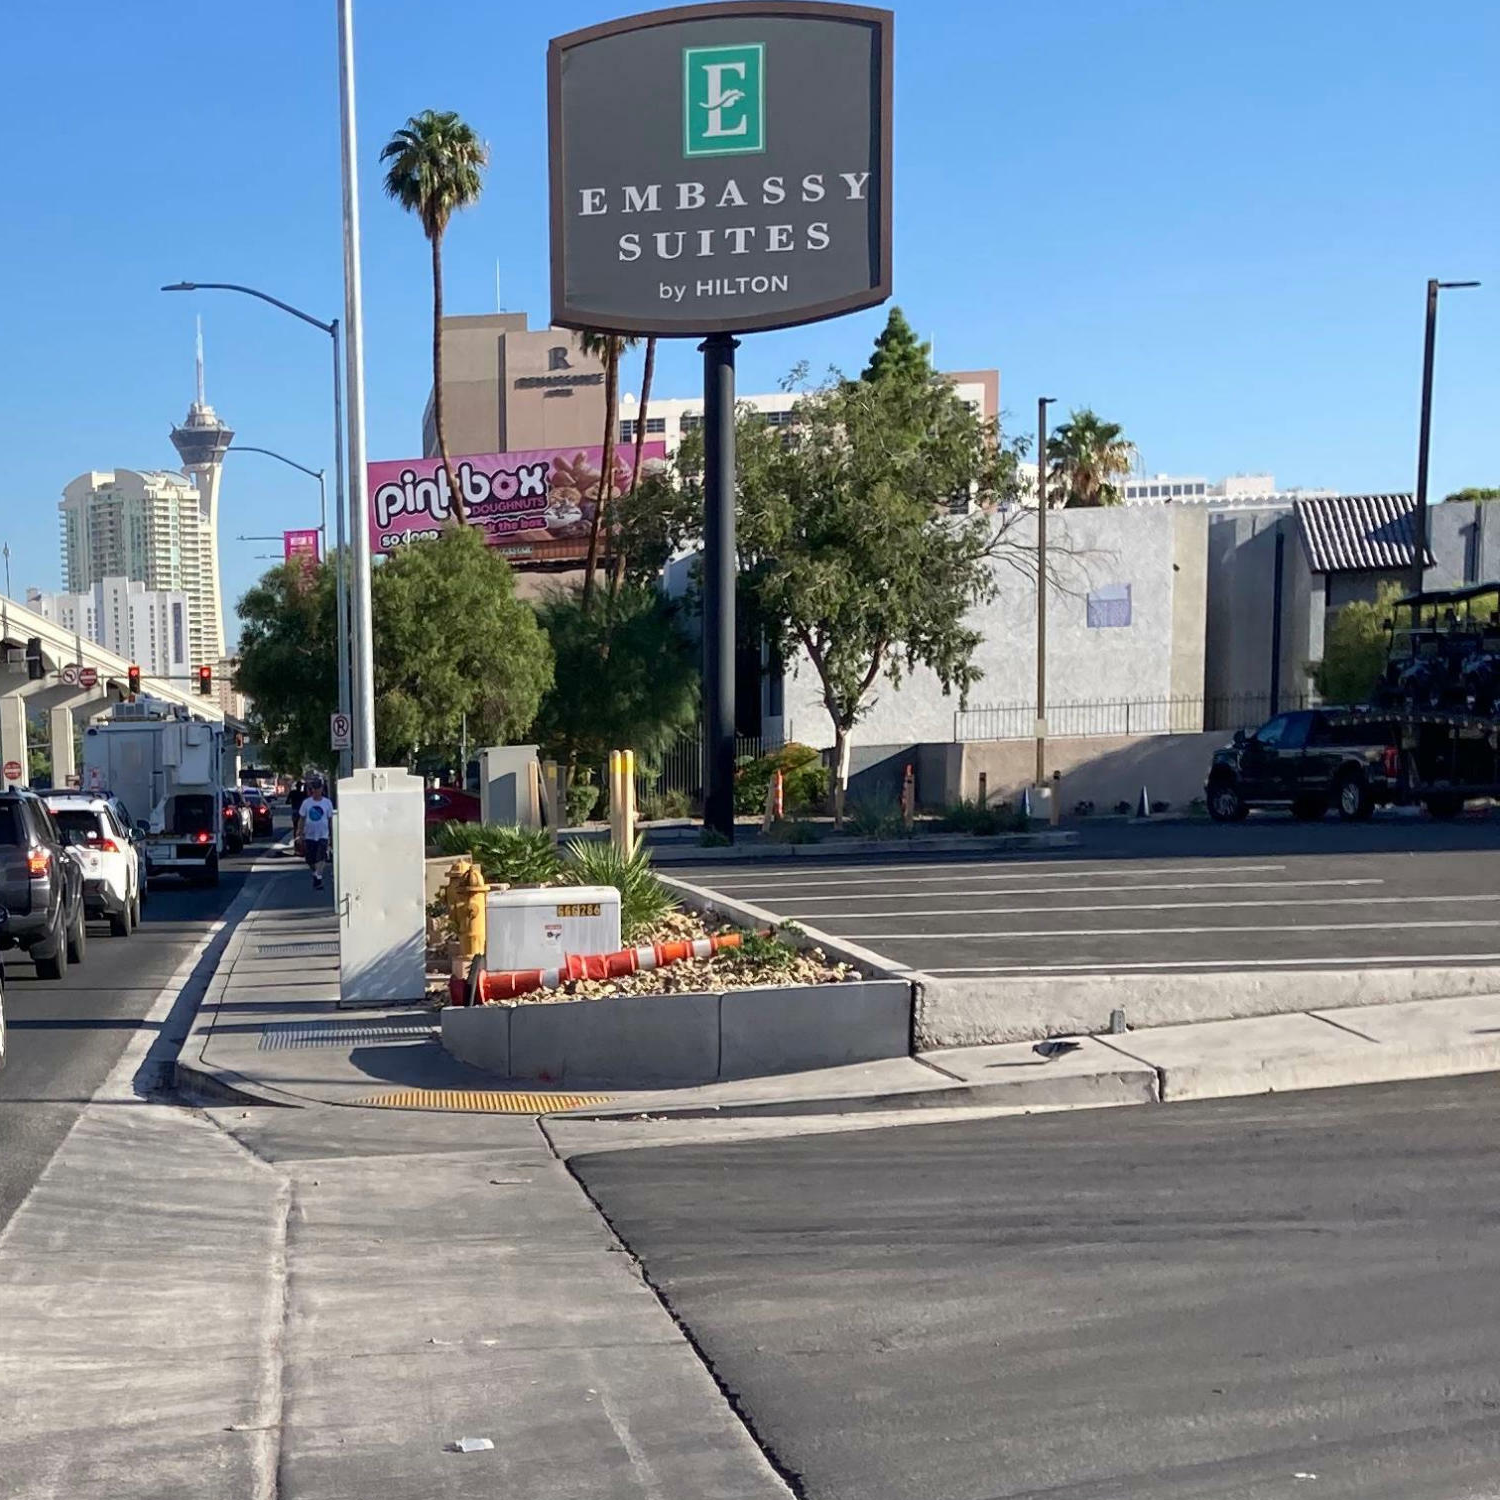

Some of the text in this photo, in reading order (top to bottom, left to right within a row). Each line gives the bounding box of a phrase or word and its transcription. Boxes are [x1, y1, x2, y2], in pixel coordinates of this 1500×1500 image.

[578, 172, 871, 216] EMBASSY
[618, 222, 830, 262] SUITES
[659, 275, 789, 302] by HILTON
[472, 497, 546, 515] DOUGHNUTS
[499, 521, 518, 531] the
